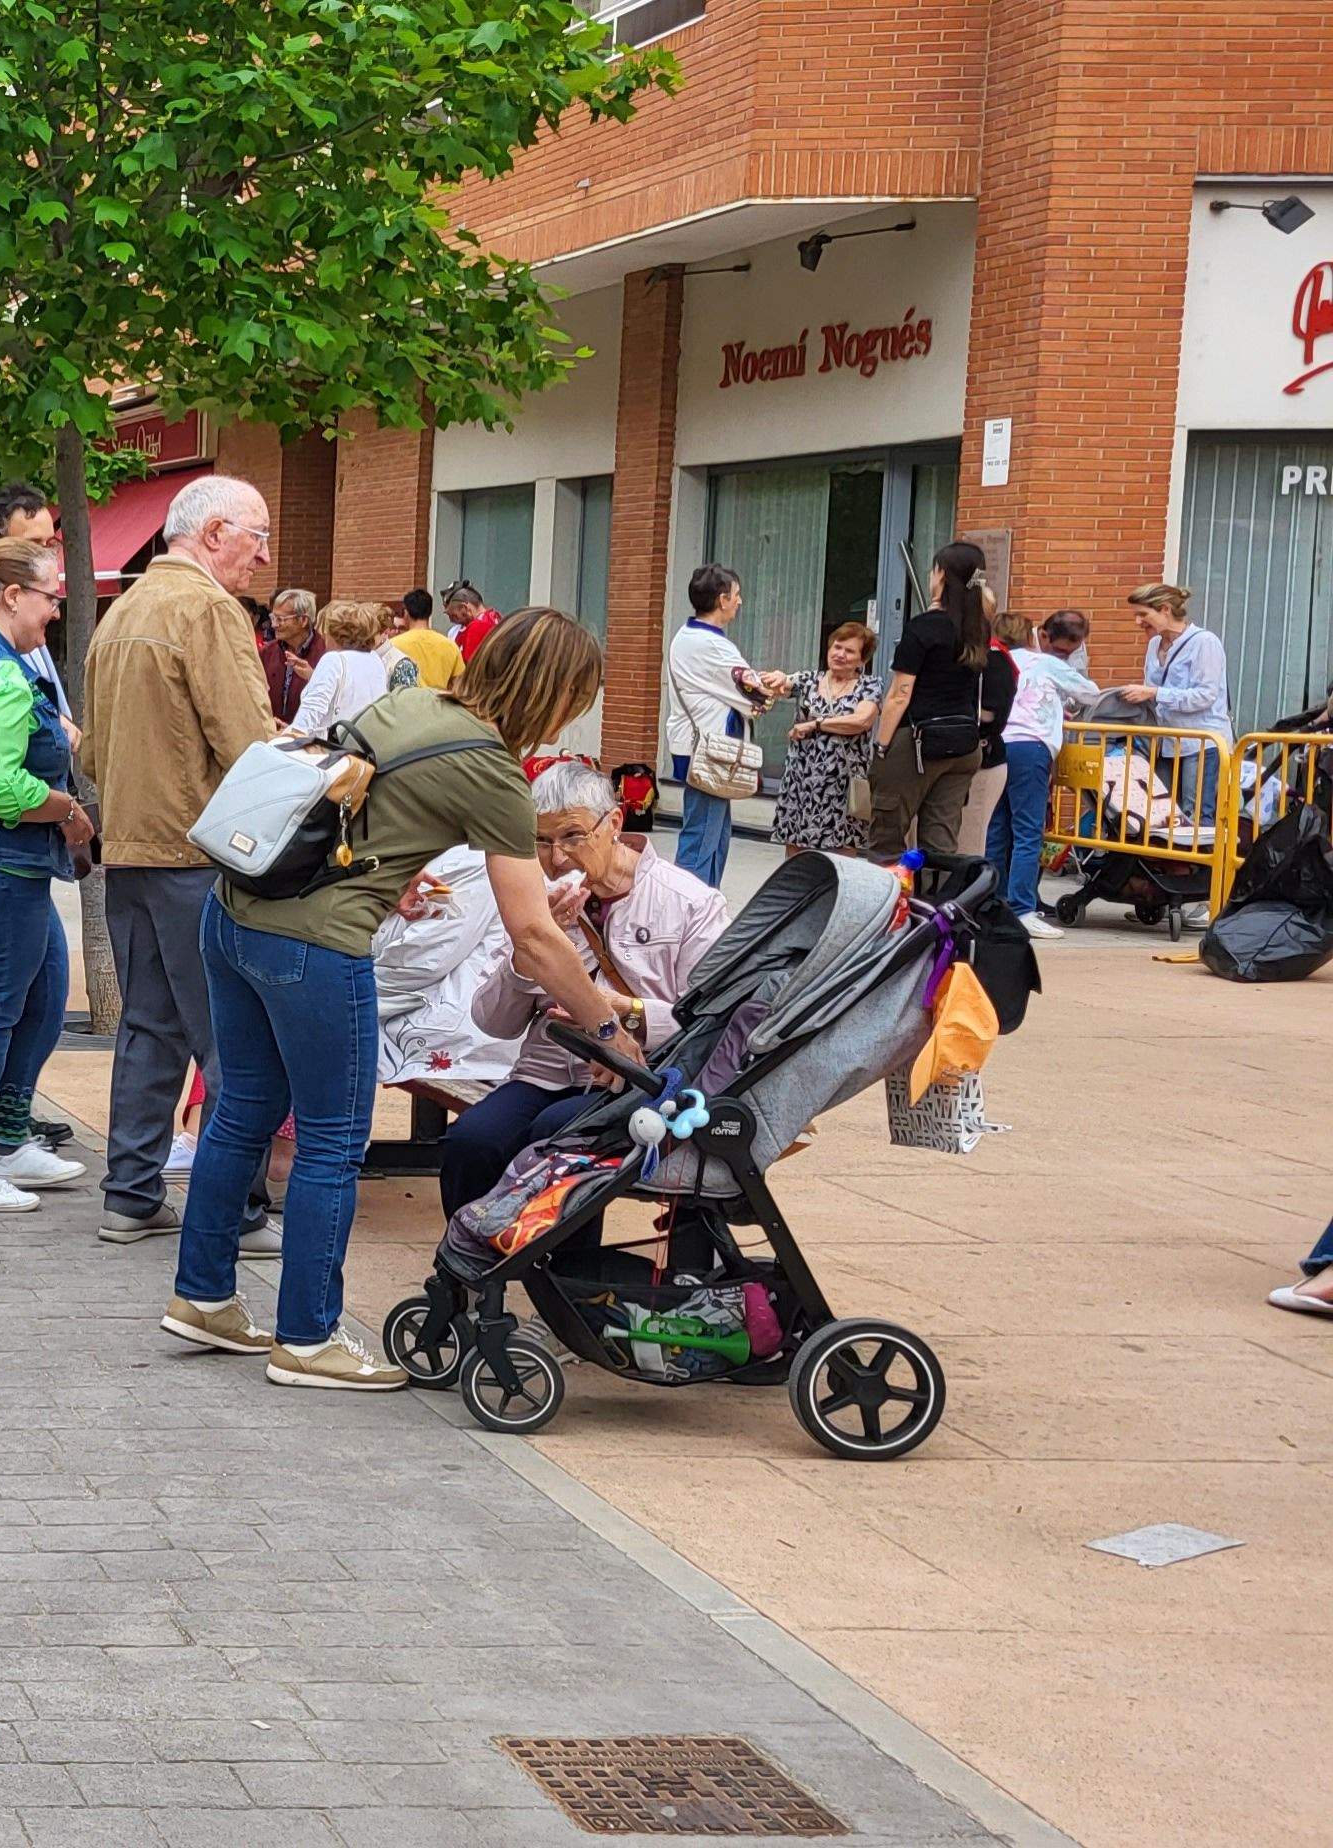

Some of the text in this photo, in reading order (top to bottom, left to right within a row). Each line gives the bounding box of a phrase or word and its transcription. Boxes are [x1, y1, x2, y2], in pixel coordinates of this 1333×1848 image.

[719, 306, 933, 389] Noemí Nogués
[1281, 464, 1333, 496] PR
